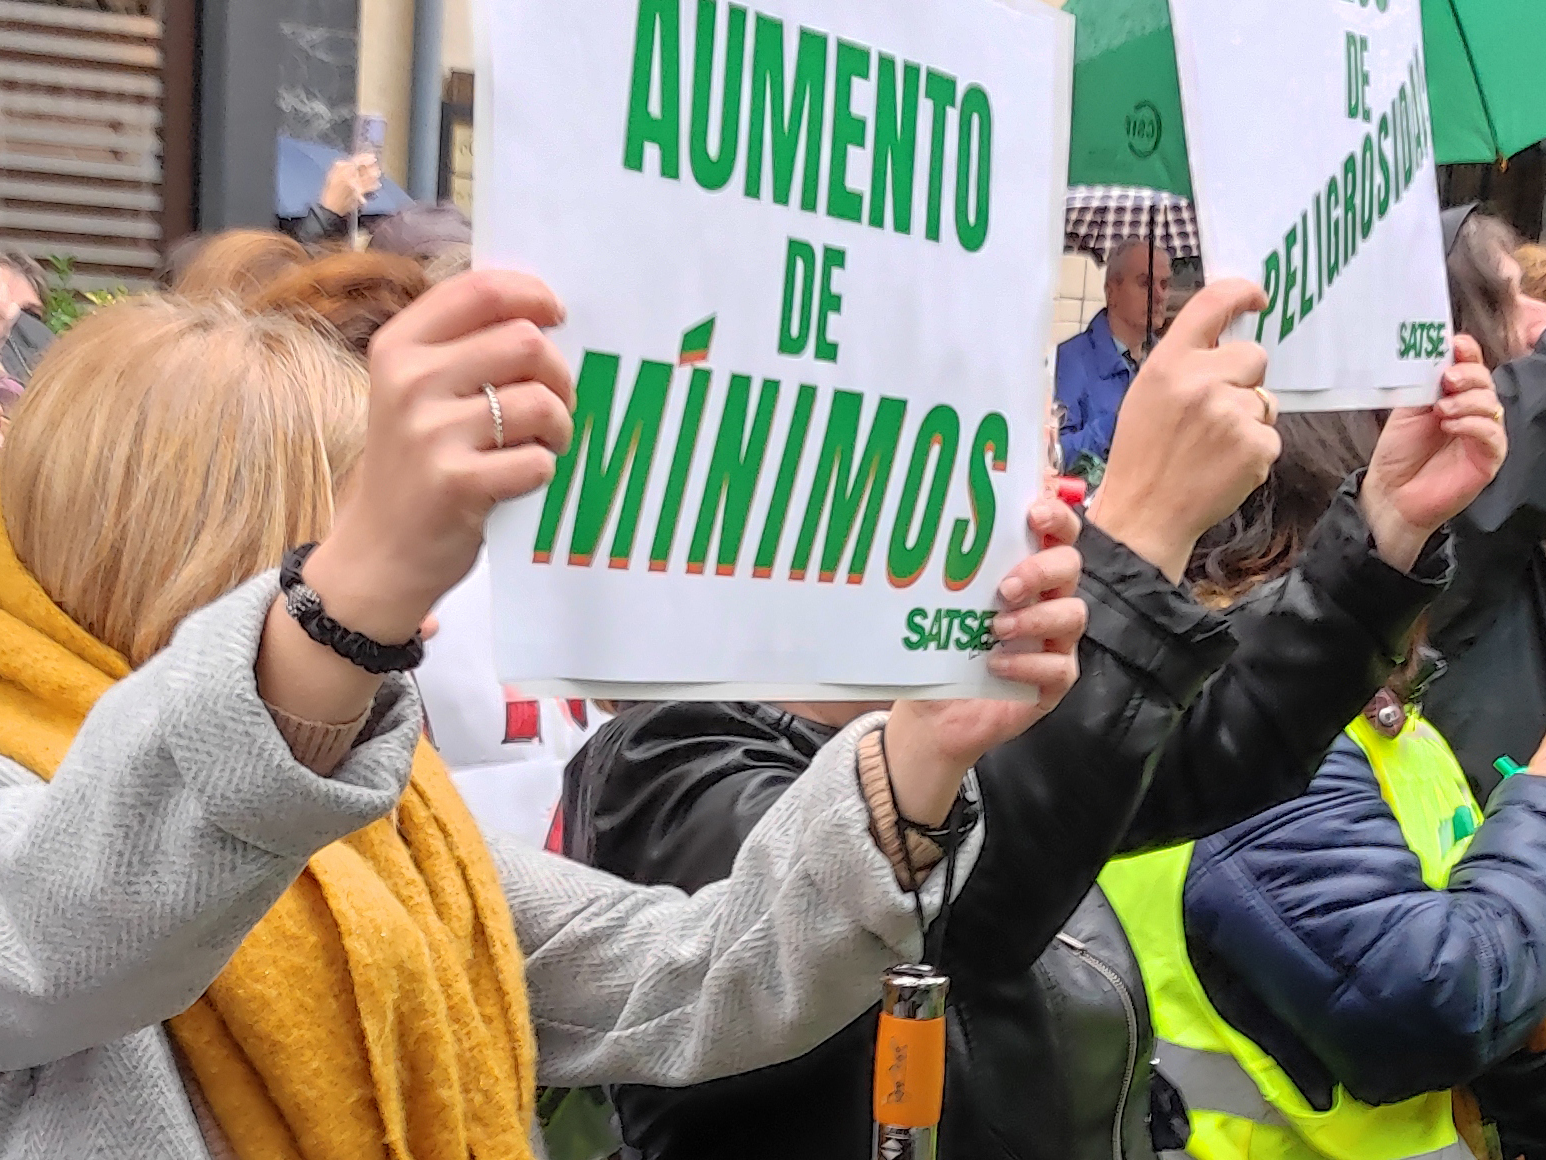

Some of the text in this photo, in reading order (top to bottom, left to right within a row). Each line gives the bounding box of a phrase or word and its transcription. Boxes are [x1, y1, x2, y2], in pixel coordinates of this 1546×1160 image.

[622, 0, 992, 253] AUMENTO
[1344, 29, 1371, 122] DE
[776, 235, 846, 364] DE
[1397, 320, 1447, 360] SATSE
[531, 313, 1009, 592] MÍNIMOS
[901, 606, 998, 652] SATSE
